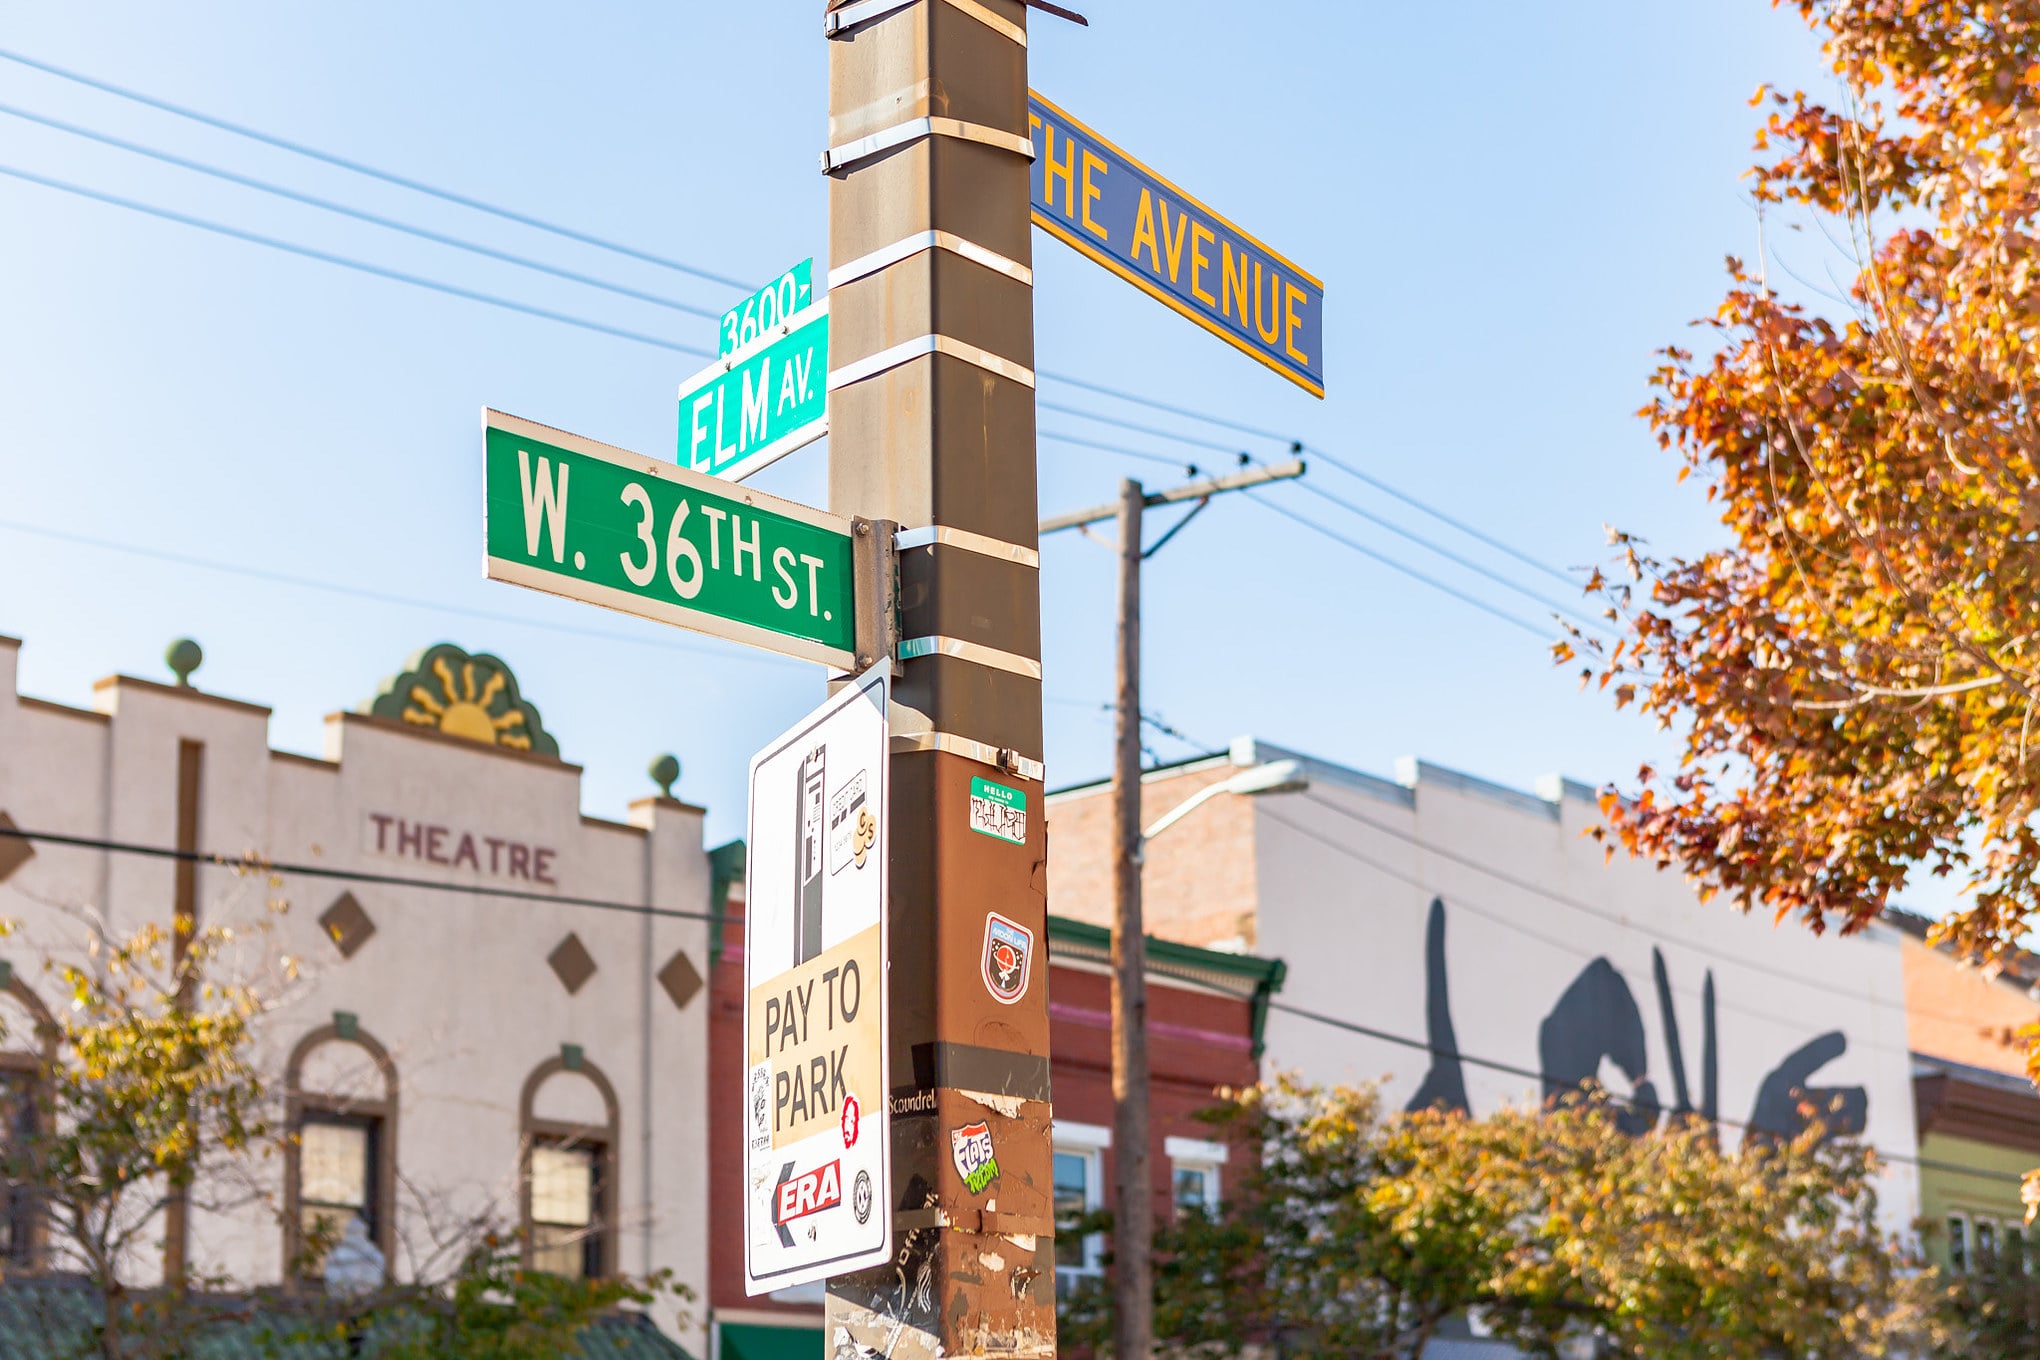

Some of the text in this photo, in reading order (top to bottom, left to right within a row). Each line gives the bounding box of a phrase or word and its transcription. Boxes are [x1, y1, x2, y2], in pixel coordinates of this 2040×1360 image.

[721, 272, 798, 359] 3600
[1130, 187, 1309, 366] AVENUE
[690, 347, 815, 474] ELM AV.
[517, 449, 832, 621] W. 36TH ST.
[983, 784, 1013, 801] HELLO
[368, 812, 559, 887] THEATRE
[765, 959, 861, 1058] PAY TO
[775, 1044, 850, 1132] PARK
[779, 1163, 841, 1222] ERA
[954, 1133, 994, 1181] FLATS
